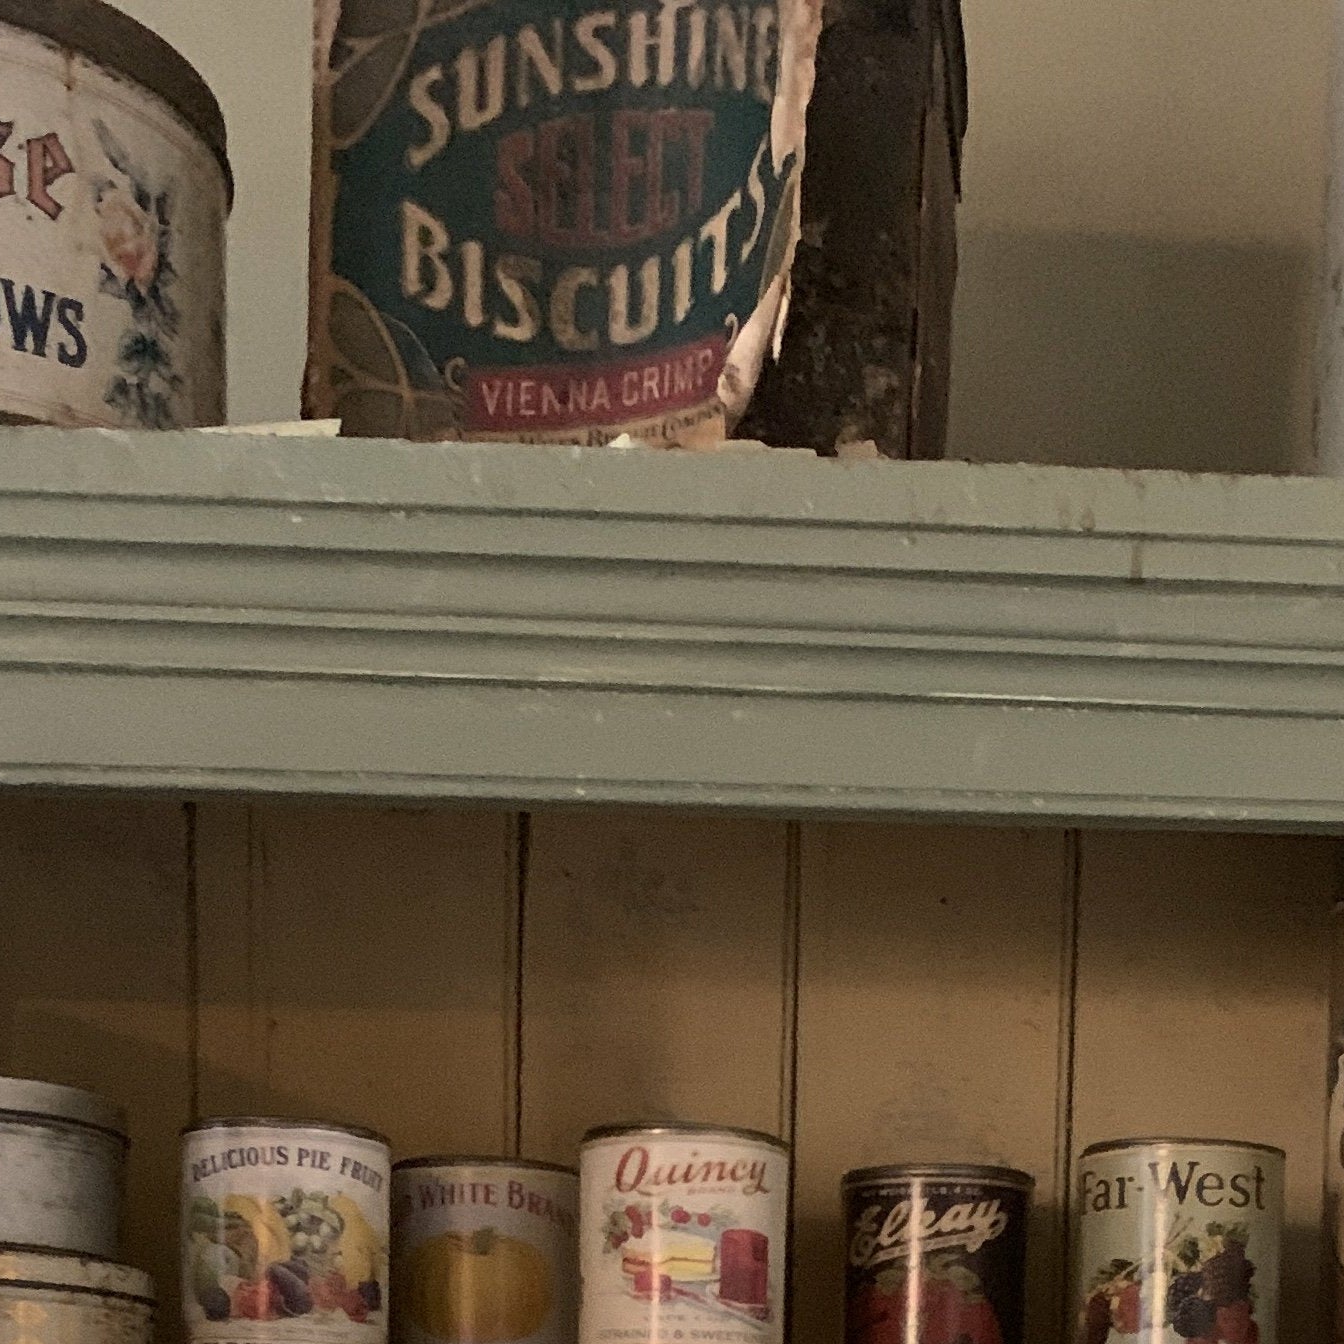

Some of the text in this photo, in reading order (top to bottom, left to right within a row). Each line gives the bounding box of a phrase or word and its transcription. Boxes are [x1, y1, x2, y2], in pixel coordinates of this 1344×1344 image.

[404, 2, 776, 169] SUNSHINE
[494, 108, 716, 247] SELECT
[400, 132, 771, 351] BISCUITS
[481, 349, 713, 417] VIENNA CRIMP
[192, 1146, 289, 1182] DELICIOUS
[297, 1147, 331, 1171] PIE
[419, 1181, 497, 1210] WHITE
[614, 1146, 771, 1197] Quincy
